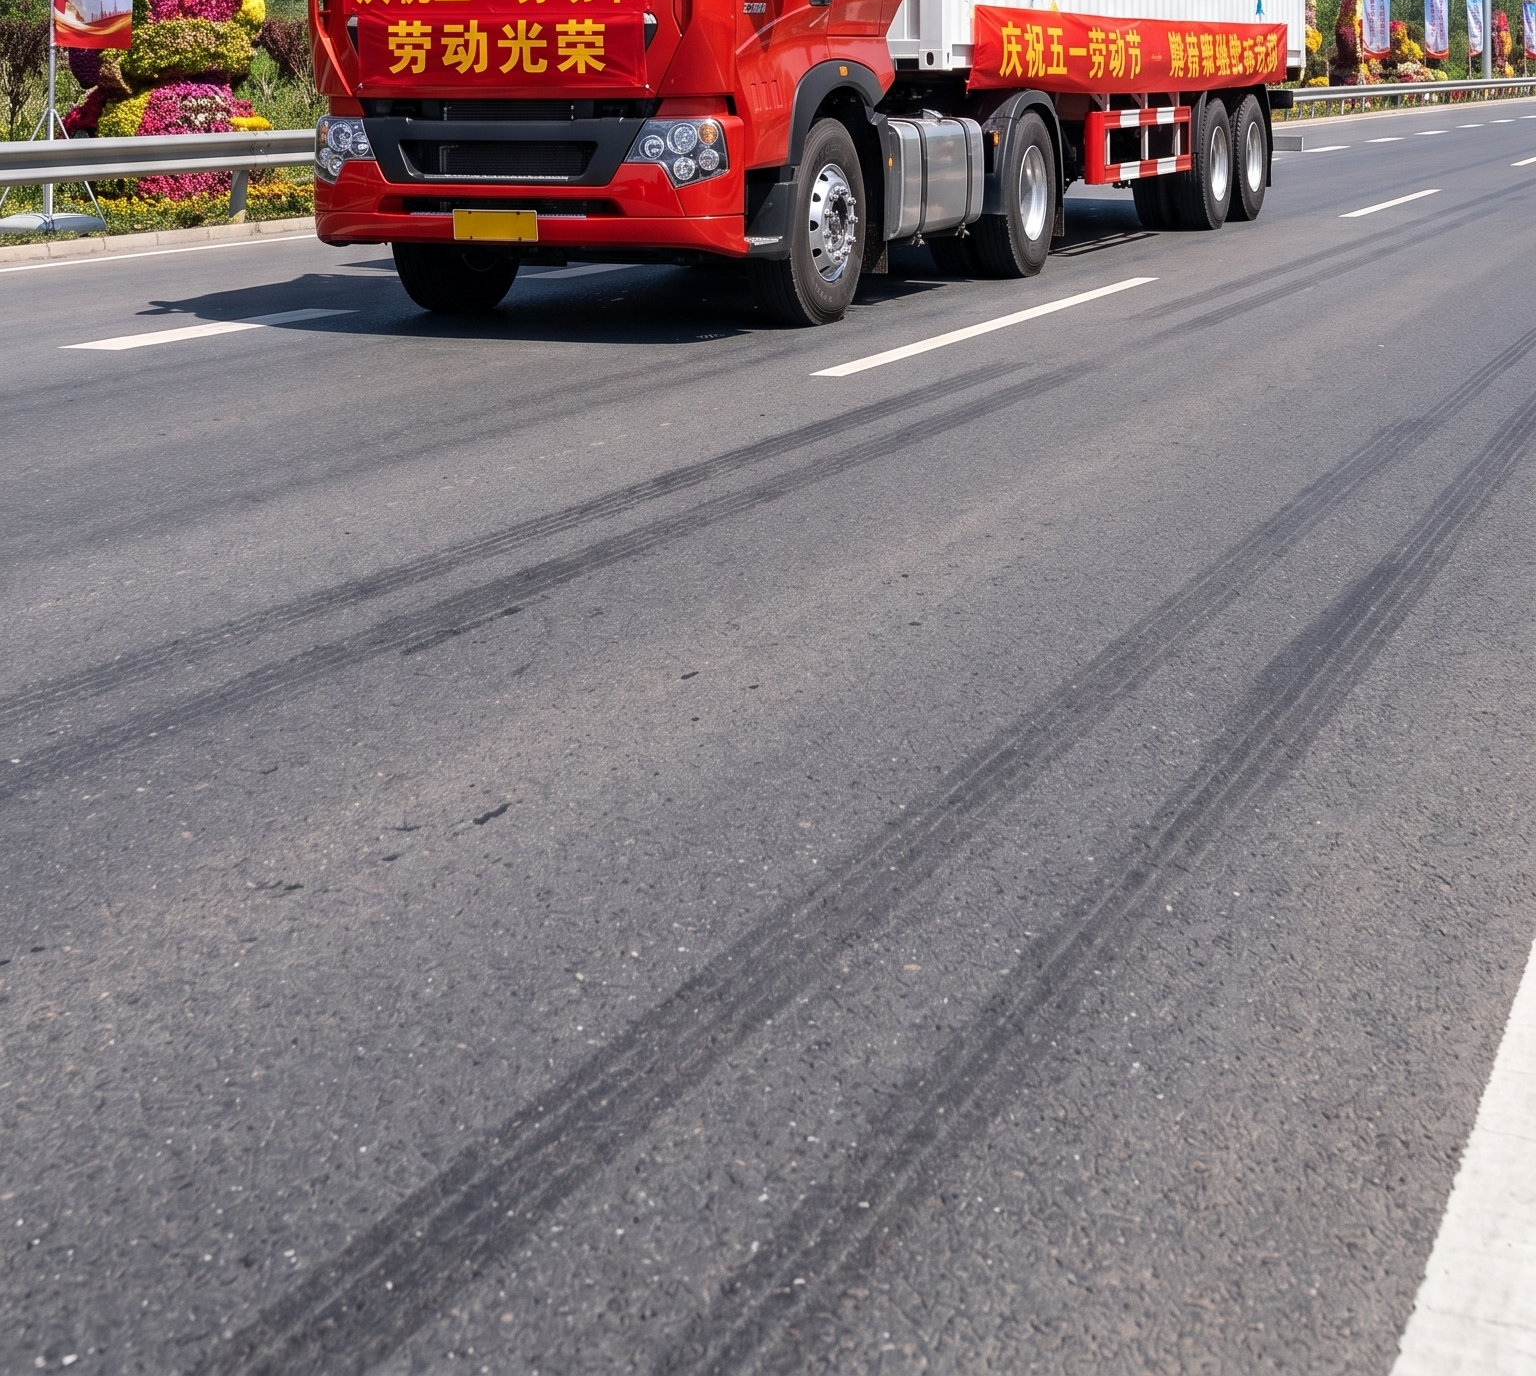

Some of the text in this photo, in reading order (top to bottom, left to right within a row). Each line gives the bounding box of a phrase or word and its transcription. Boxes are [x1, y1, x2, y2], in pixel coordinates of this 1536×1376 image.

[387, 19, 606, 74] 劳动光荣
[999, 21, 1142, 80] 庆祝五一劳动节
